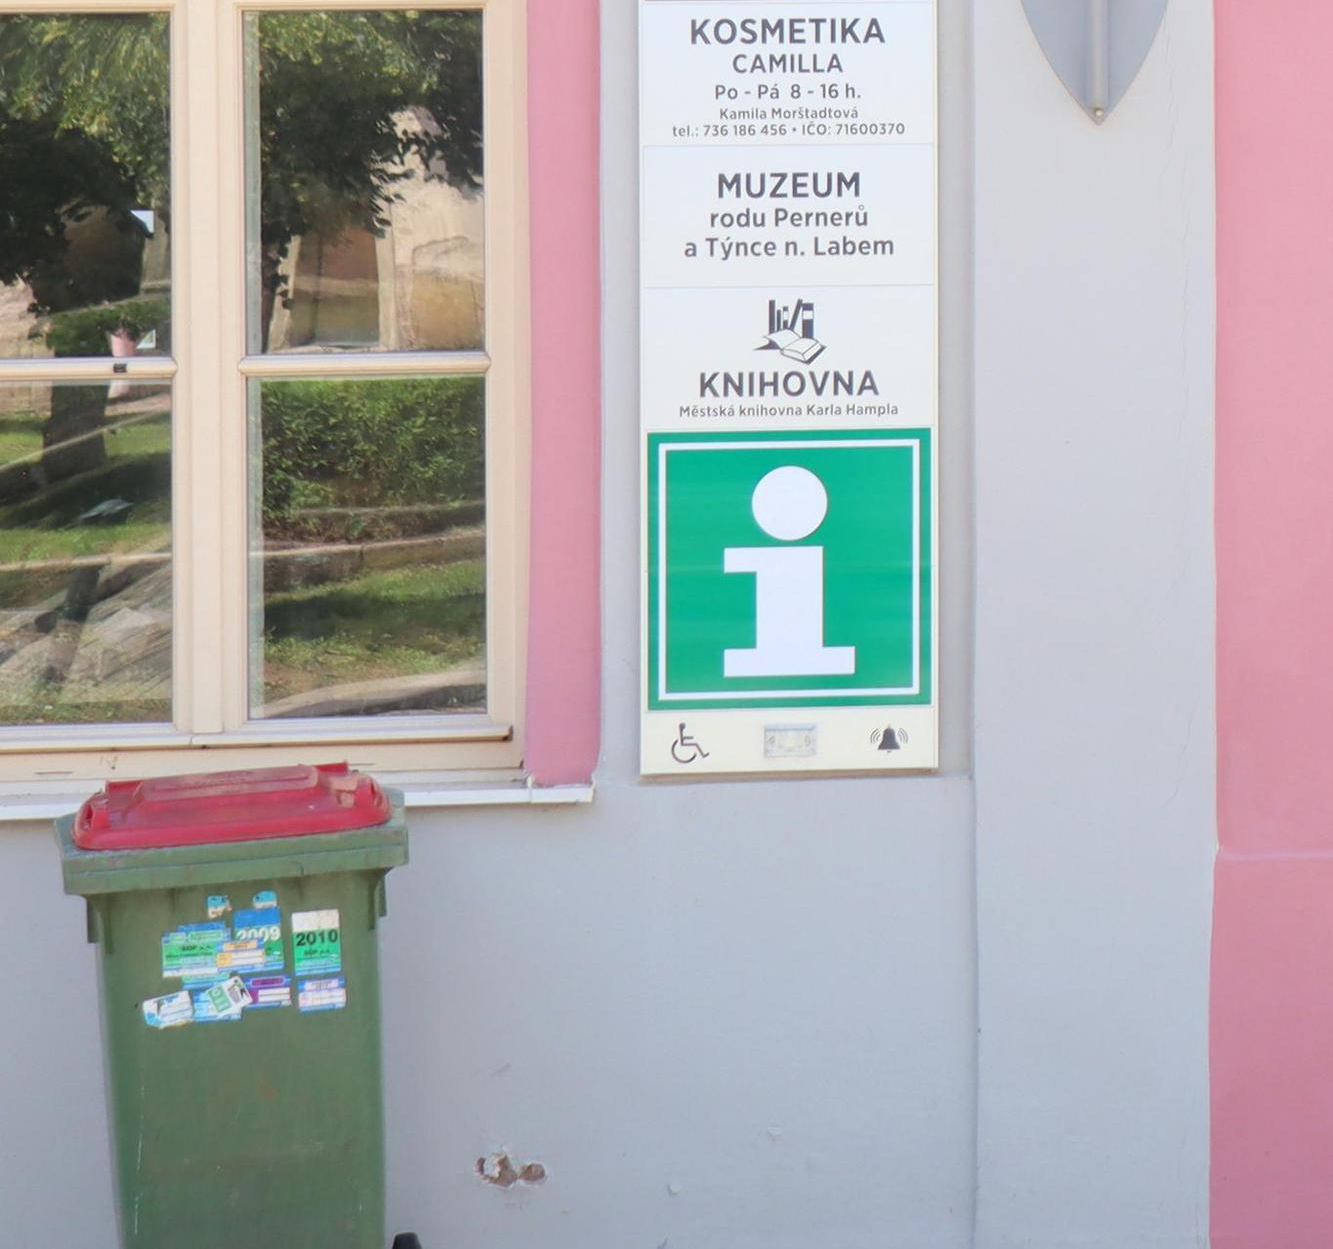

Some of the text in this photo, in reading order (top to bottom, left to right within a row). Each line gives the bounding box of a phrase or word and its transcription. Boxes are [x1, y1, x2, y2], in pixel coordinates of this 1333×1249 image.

[690, 17, 886, 45] KOSMETIKA
[732, 53, 844, 74] CAMILLA
[715, 84, 739, 100] Po
[757, 83, 780, 100] Pá
[790, 83, 802, 100] 8
[820, 83, 839, 99] 16
[845, 83, 861, 99] h.
[719, 106, 859, 120] Kamila Morštadtová
[672, 120, 906, 137] tel.: 736 186 456 IČO: 71600370
[718, 171, 860, 199] MUZEUM
[710, 204, 868, 228] rodu Pernerů
[684, 235, 894, 261] a Týnce n. Labem
[699, 370, 880, 398] KNIHOVNA
[679, 402, 899, 418] Městská knihovna Karla Hampla
[295, 928, 339, 947] 2010
